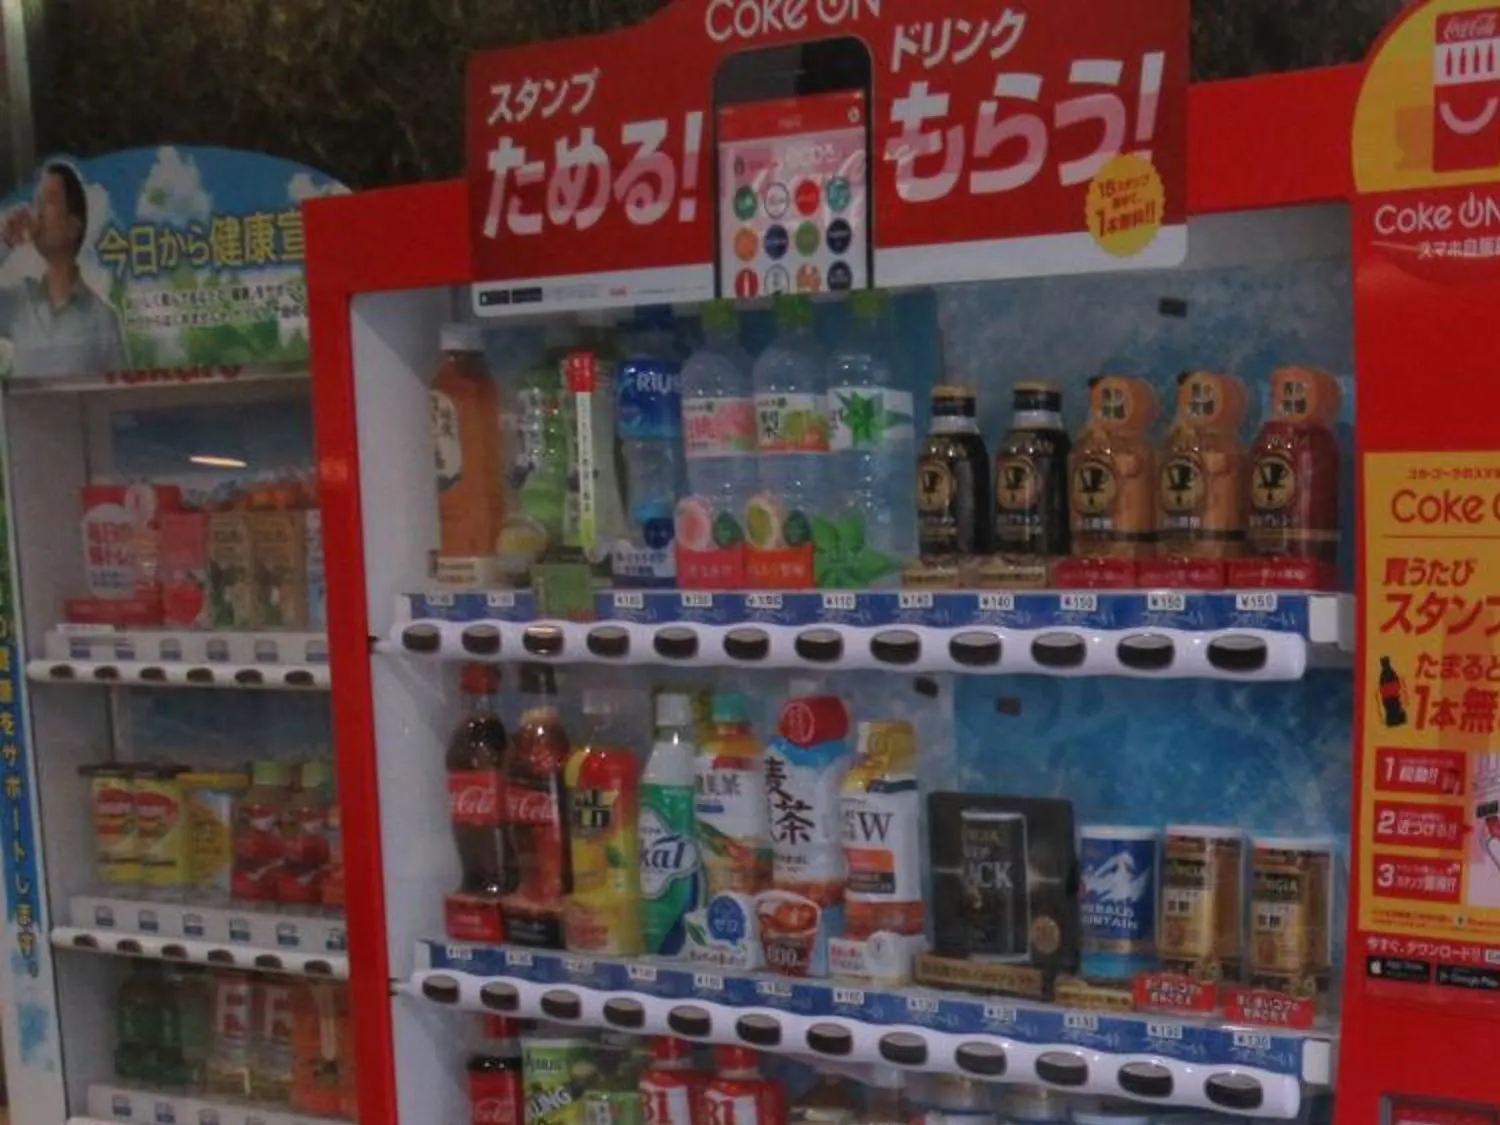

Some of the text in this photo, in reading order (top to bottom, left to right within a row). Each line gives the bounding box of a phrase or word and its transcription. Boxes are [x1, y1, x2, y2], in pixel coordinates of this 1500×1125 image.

[889, 7, 1028, 74] ドリンク
[486, 63, 606, 127] スタンプ
[482, 110, 704, 240] ためる!
[1374, 200, 1453, 236] Coke
[1390, 488, 1486, 525] Coke
[1381, 557, 1479, 588] 買うたび
[763, 754, 817, 846] 麦茶
[857, 811, 894, 844] W
[1376, 809, 1396, 835] 2
[1376, 863, 1395, 888] 3
